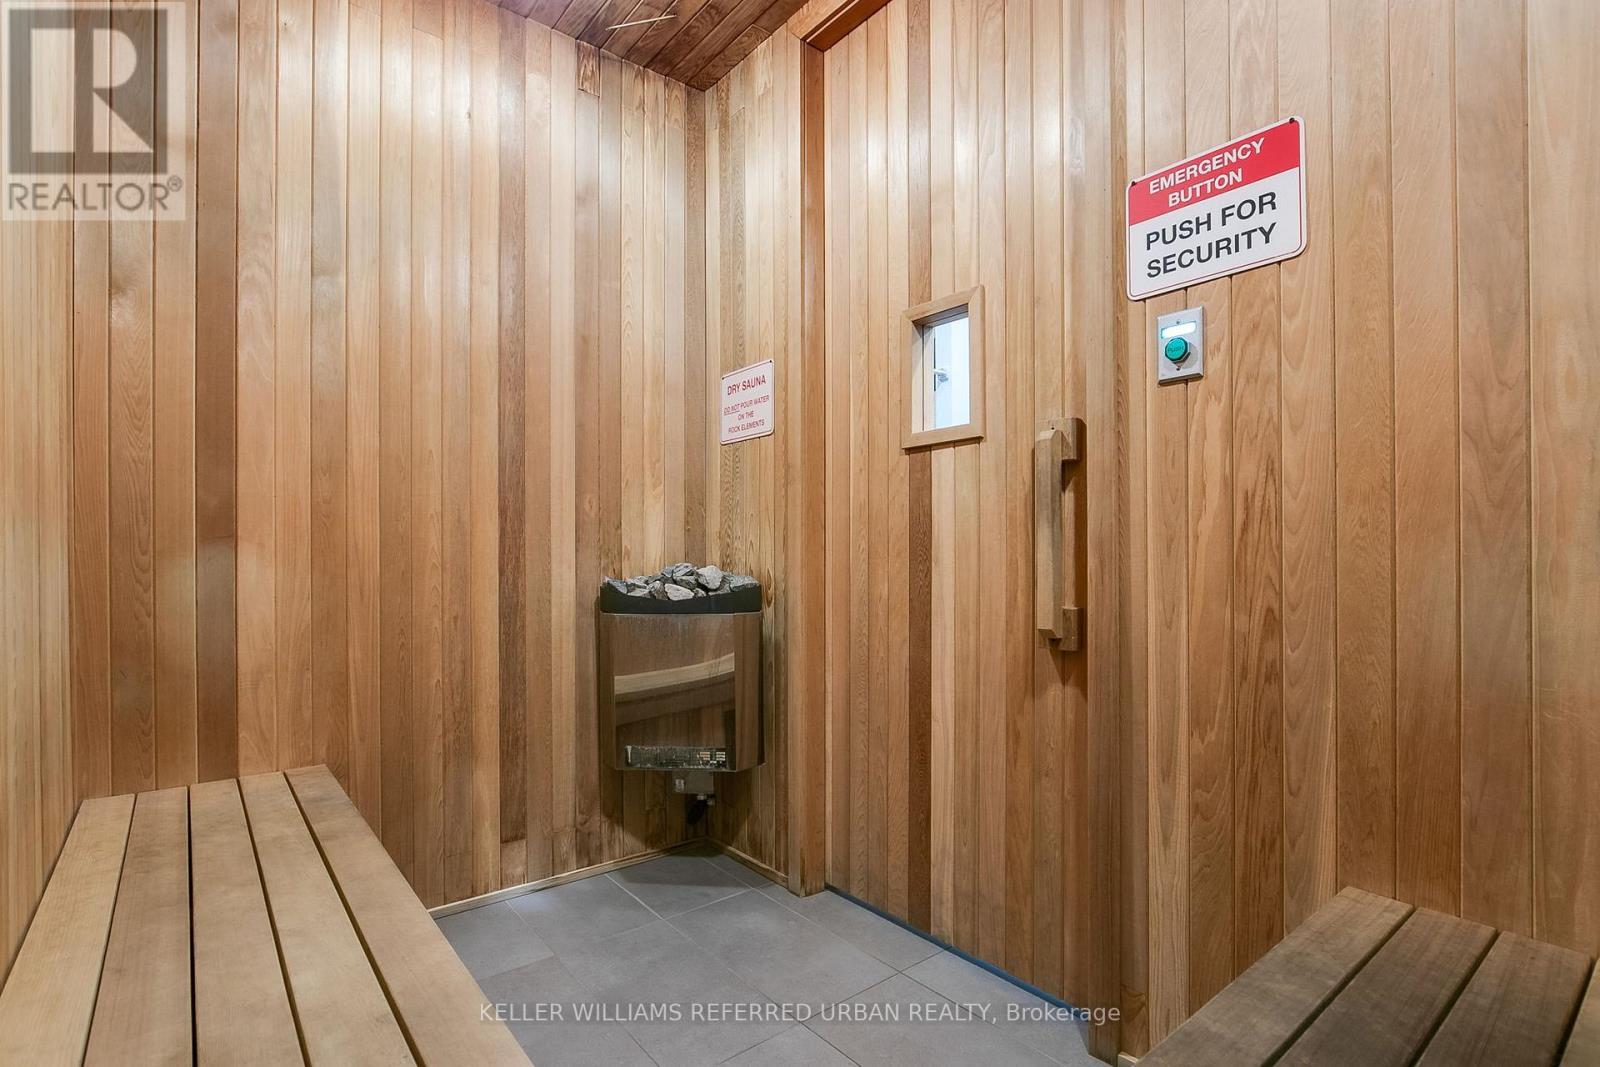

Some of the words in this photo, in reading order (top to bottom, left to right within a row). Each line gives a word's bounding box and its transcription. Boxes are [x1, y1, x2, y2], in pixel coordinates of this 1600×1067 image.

[1149, 137, 1265, 194] EMERGENCY
[1168, 168, 1243, 207] BUTTON
[1146, 212, 1212, 250] PUSH
[1221, 191, 1277, 227] FOR
[1147, 222, 1277, 278] SECURITY
[727, 384, 741, 396] DRY
[742, 374, 766, 391] SAUNA
[731, 403, 740, 411] NOT
[740, 399, 753, 409] POUR
[754, 395, 769, 405] WATER
[728, 425, 740, 433] ROCK
[741, 419, 765, 431] ELEMENTS
